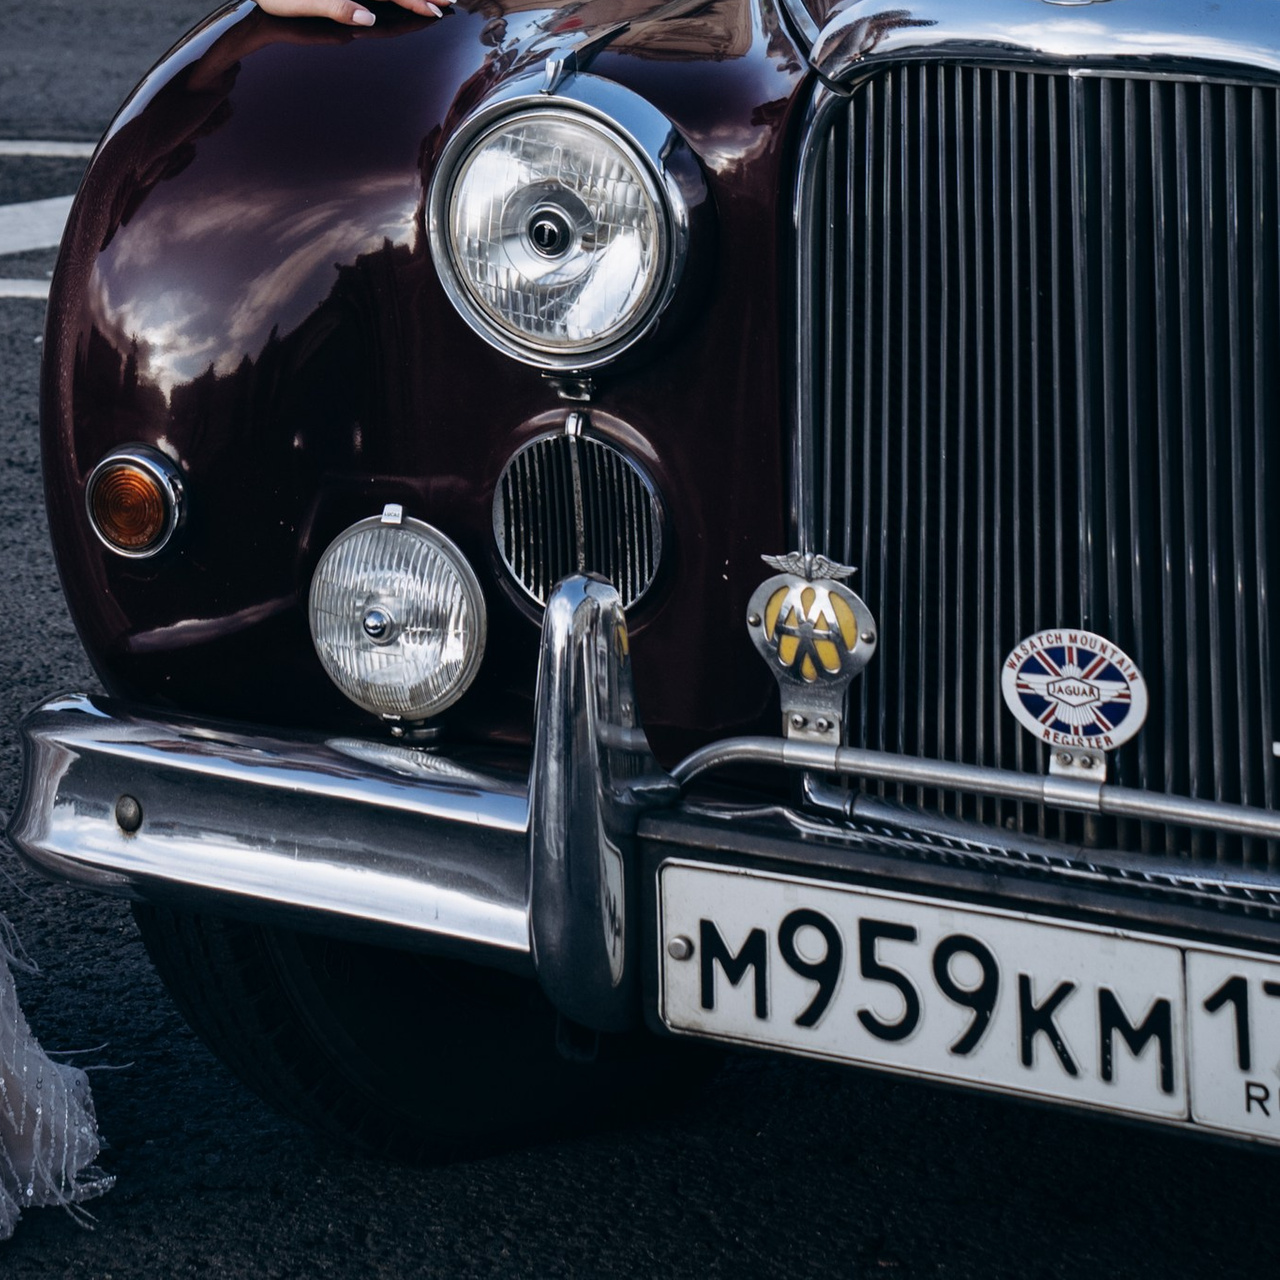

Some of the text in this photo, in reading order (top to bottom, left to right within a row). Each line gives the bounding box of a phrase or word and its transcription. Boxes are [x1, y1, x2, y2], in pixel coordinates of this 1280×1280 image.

[771, 584, 844, 671] AA
[1006, 633, 1139, 682] WASATCH MOUNTAIN
[1051, 682, 1095, 698] JAGUAR
[1042, 728, 1115, 750] REGISTER
